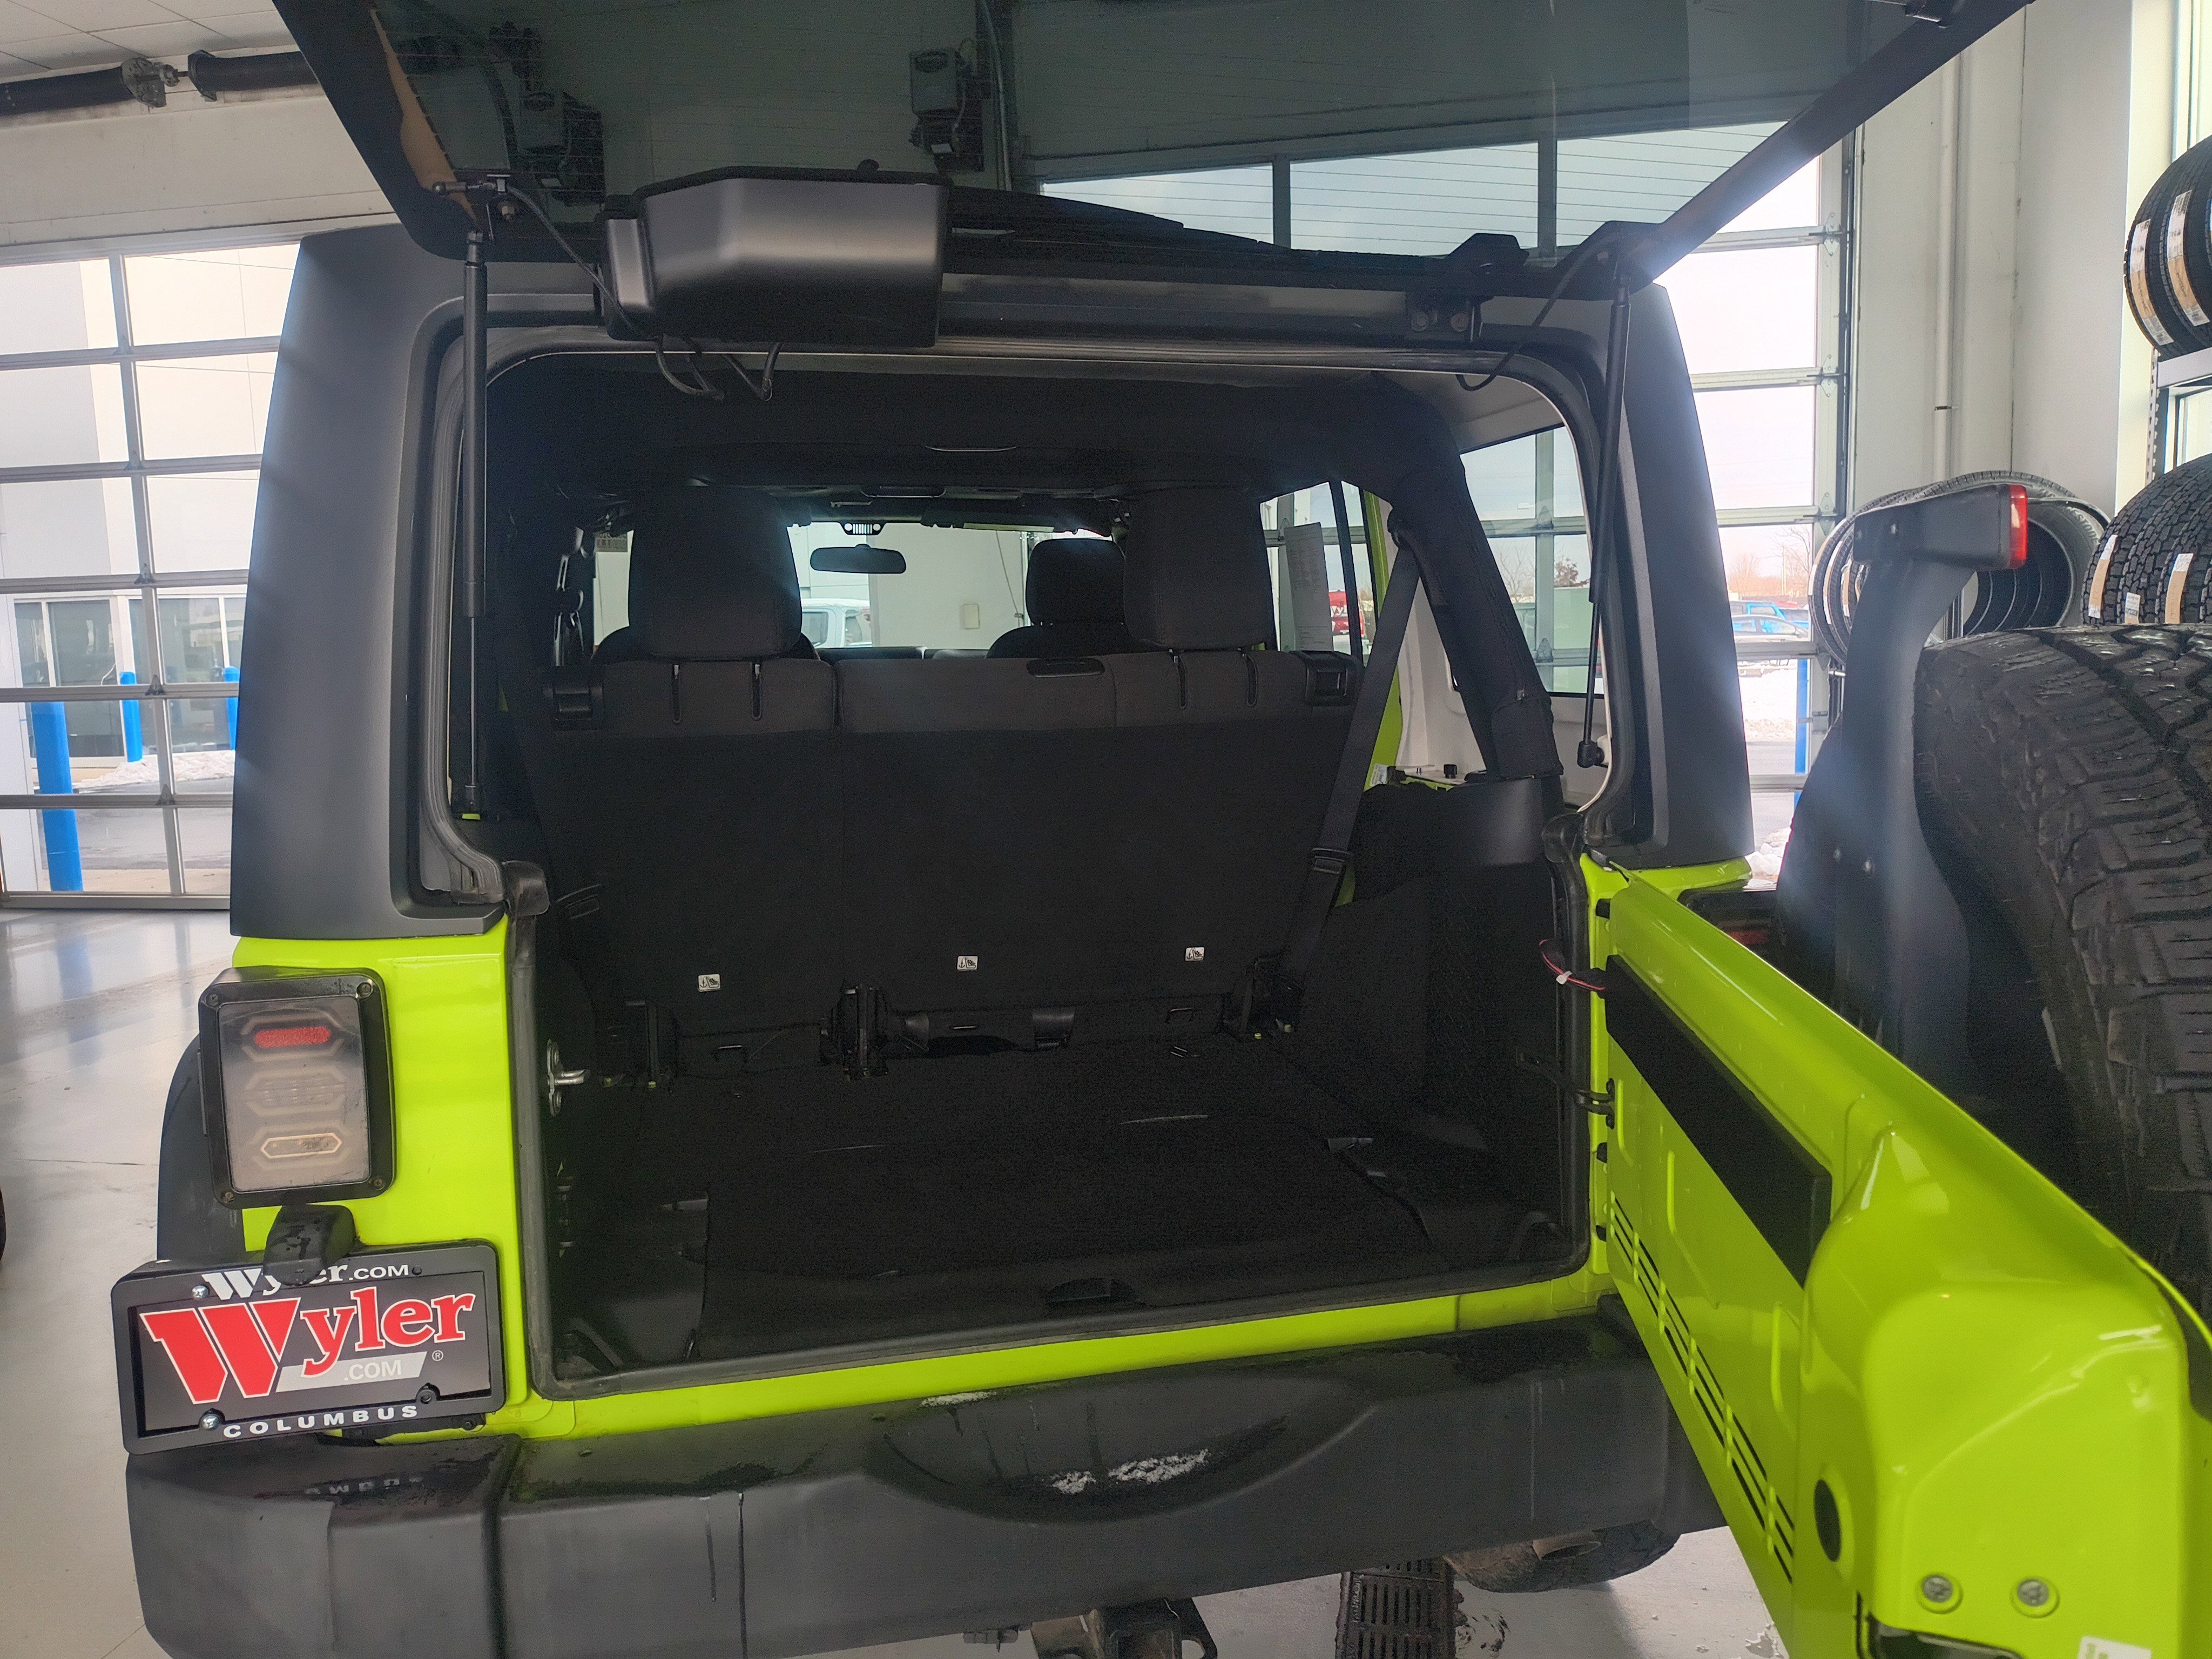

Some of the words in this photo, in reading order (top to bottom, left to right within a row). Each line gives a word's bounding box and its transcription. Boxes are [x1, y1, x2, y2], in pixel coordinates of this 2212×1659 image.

[201, 1264, 409, 1300] Wyer.COM
[139, 1286, 476, 1404] Wyler
[223, 1405, 417, 1438] COLUMBUS
